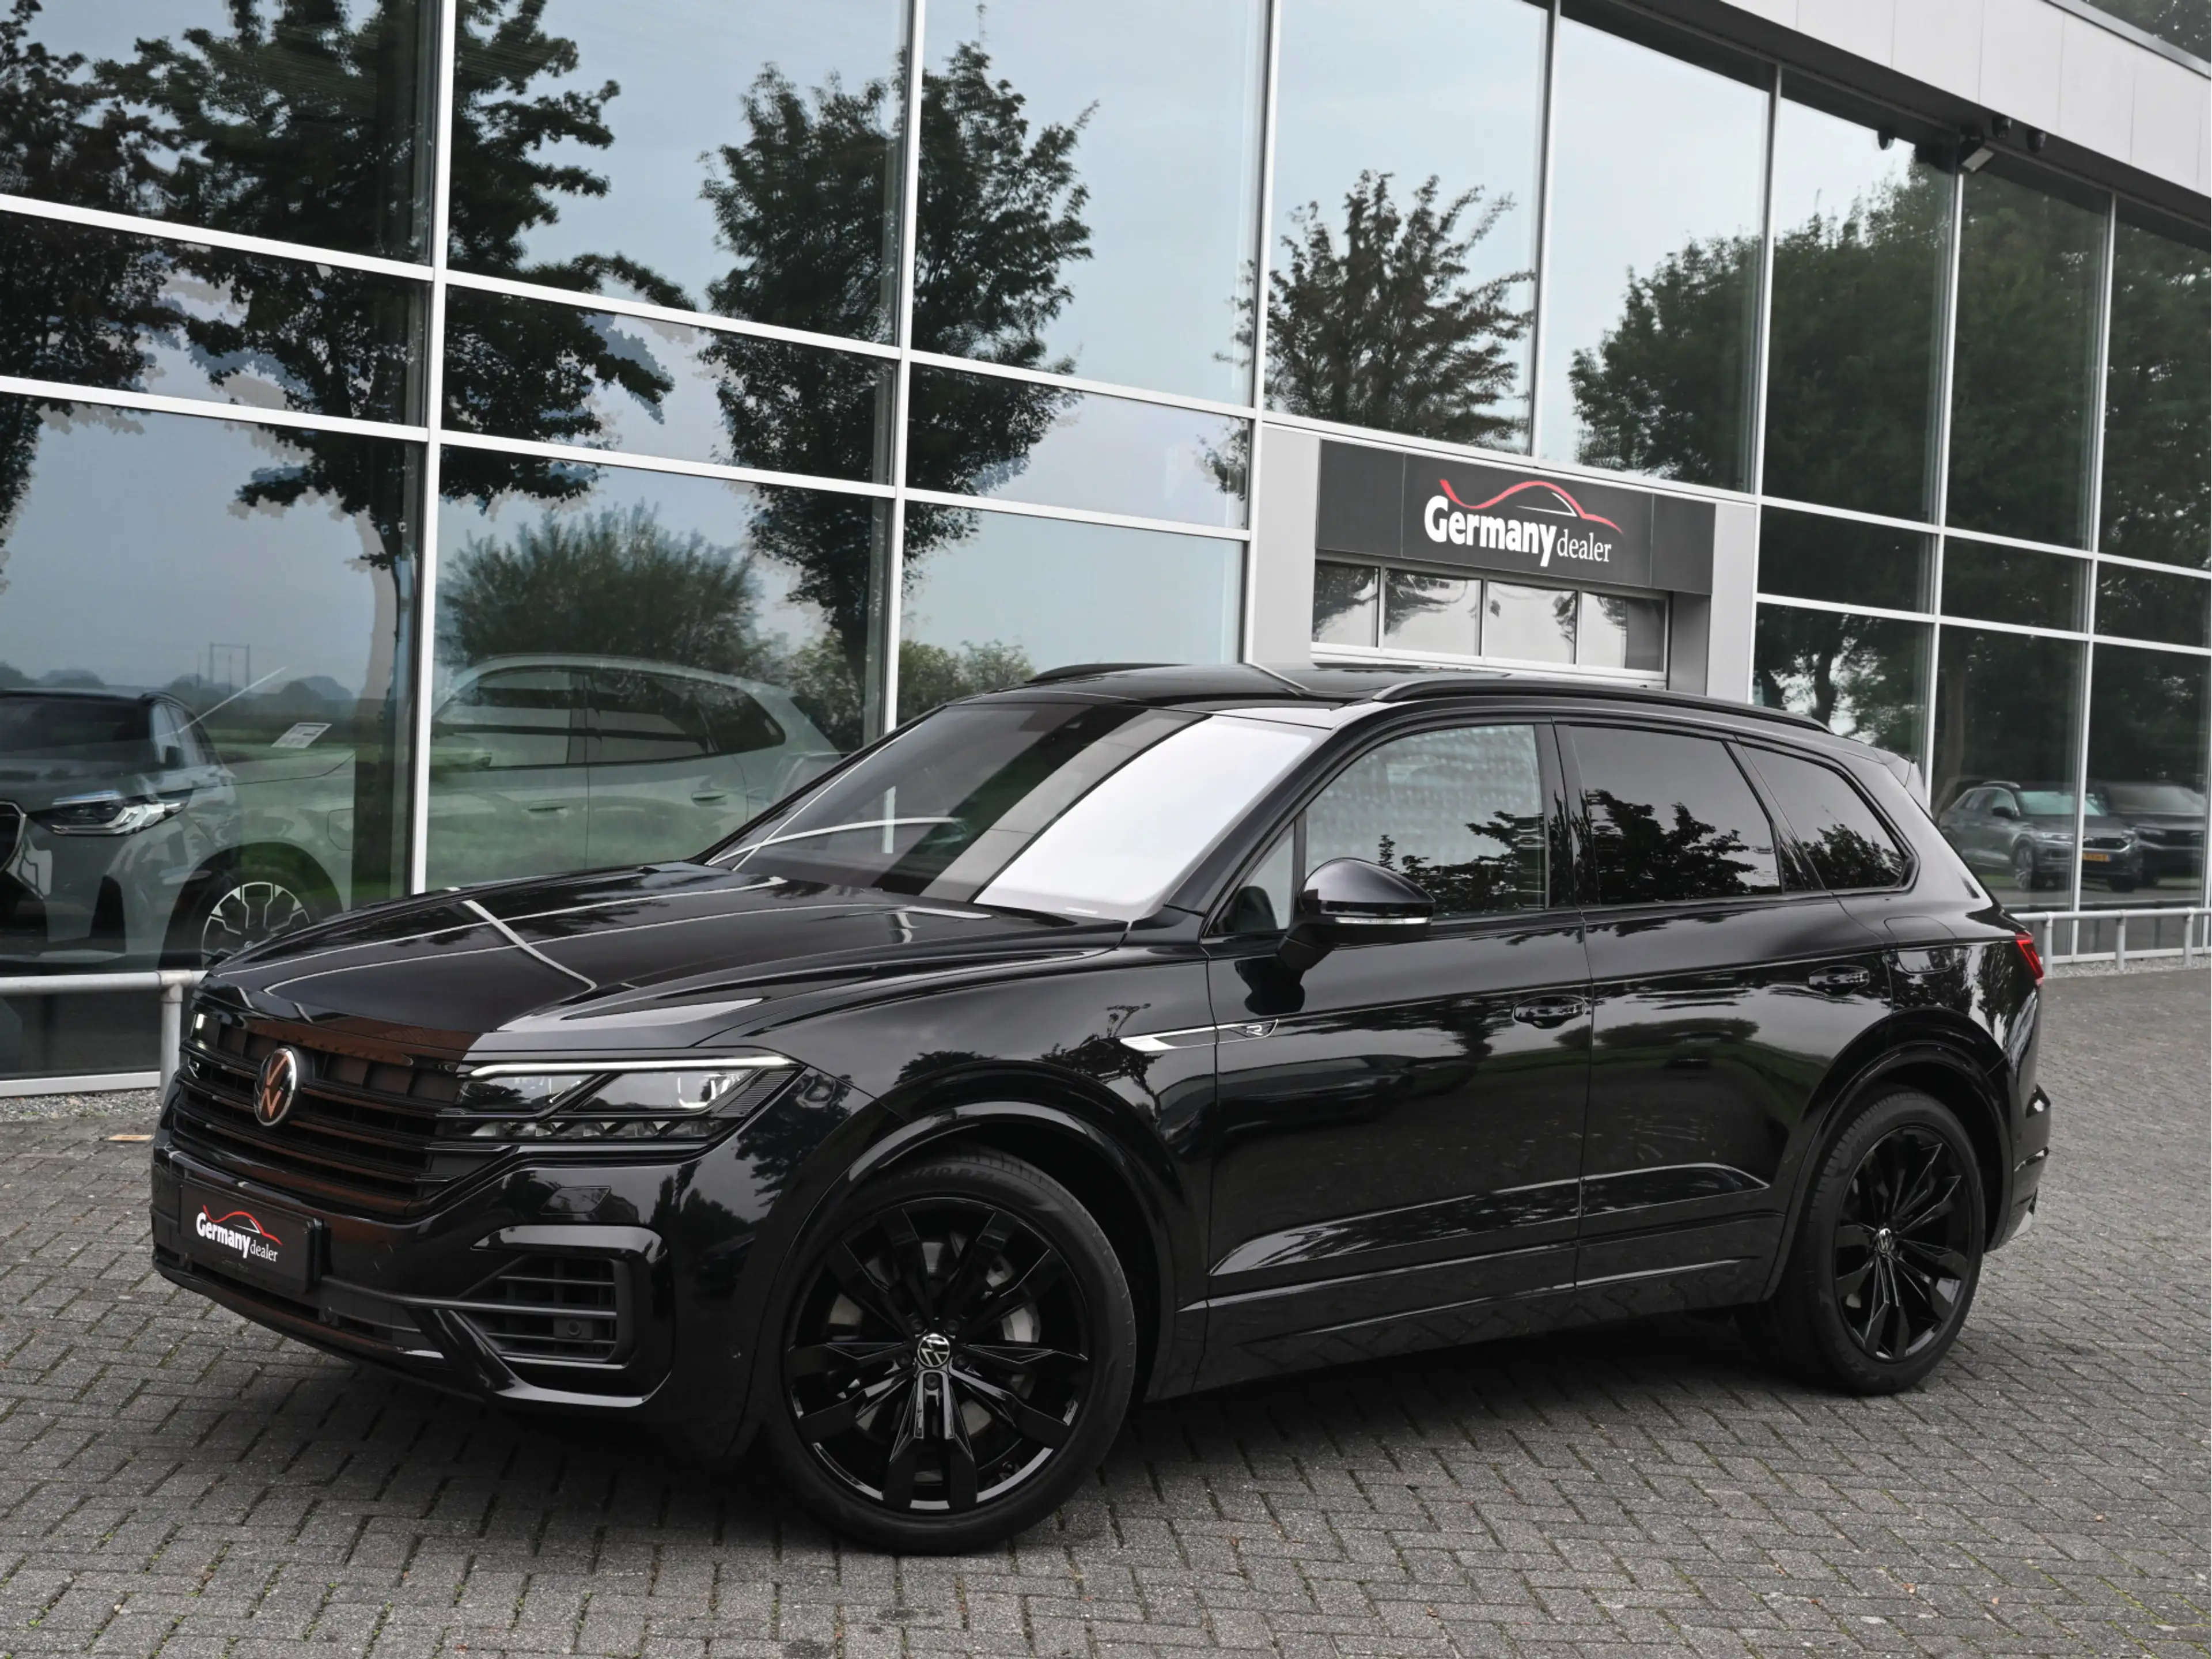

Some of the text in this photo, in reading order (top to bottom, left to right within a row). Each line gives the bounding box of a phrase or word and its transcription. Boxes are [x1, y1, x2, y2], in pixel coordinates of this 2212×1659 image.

[1425, 496, 1612, 567] Germany dealer
[196, 1212, 278, 1262] Germany dealer
